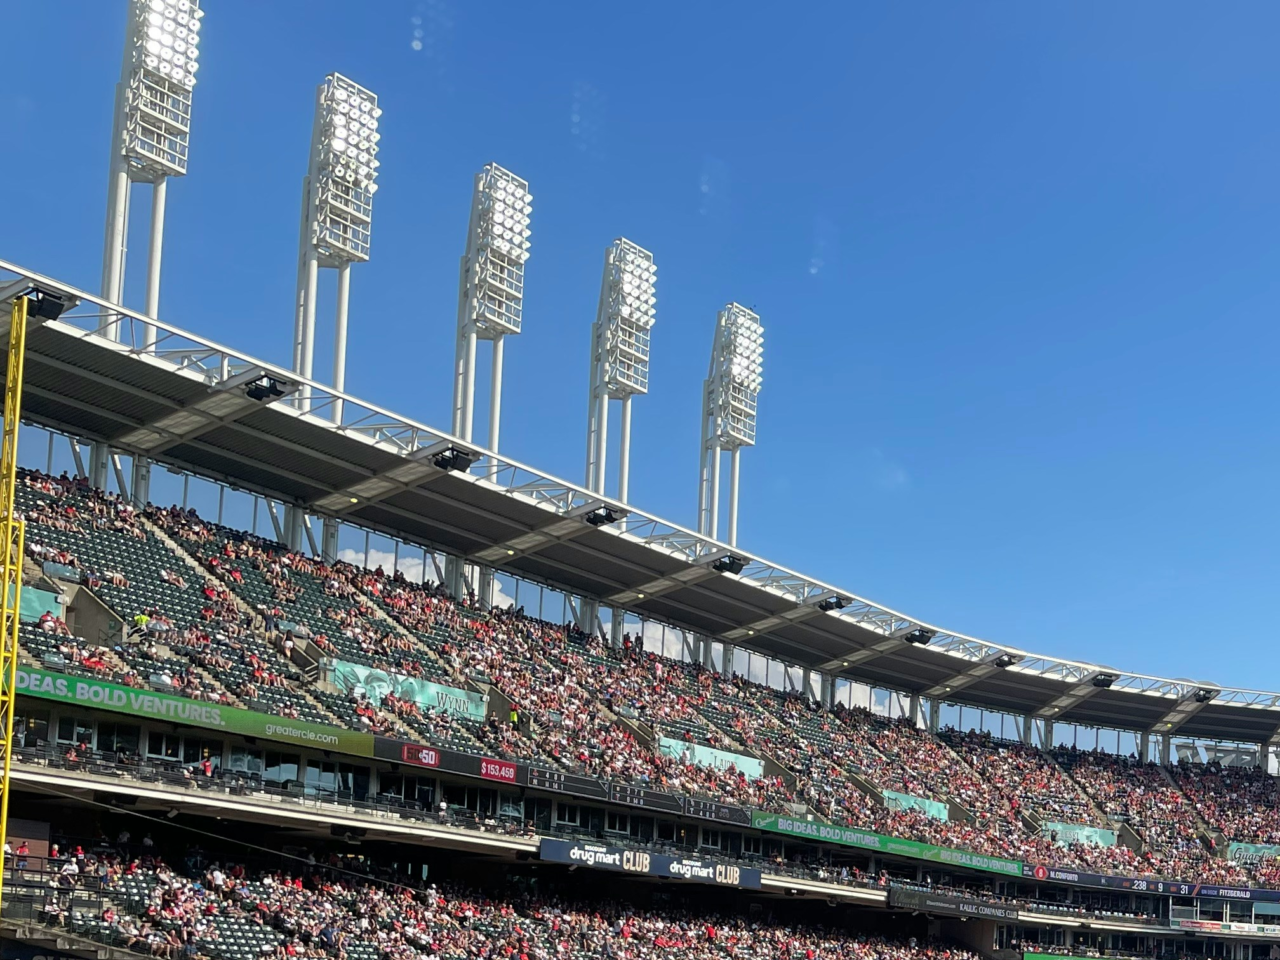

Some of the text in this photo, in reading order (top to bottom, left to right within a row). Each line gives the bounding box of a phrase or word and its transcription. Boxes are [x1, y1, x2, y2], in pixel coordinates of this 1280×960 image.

[15, 670, 226, 726] DEAS. BOLD VENTURES.
[436, 691, 470, 713] WYNN
[265, 723, 339, 746] greatercle.com
[481, 762, 515, 779] $153,459
[777, 817, 792, 831] BIG
[793, 820, 819, 836] IDEAS.
[819, 826, 840, 840] BOLD
[841, 830, 881, 848] VENTURES.
[570, 846, 650, 873] drug mart CLUB
[940, 851, 1020, 874] BIG IDEAS. BOLD VENTURES.
[670, 861, 740, 885] drug mart CLUB
[1157, 883, 1163, 893] 9
[1180, 885, 1188, 894] 31
[1219, 889, 1250, 899] FITZGERALD
[1006, 909, 1018, 919] CLUB
